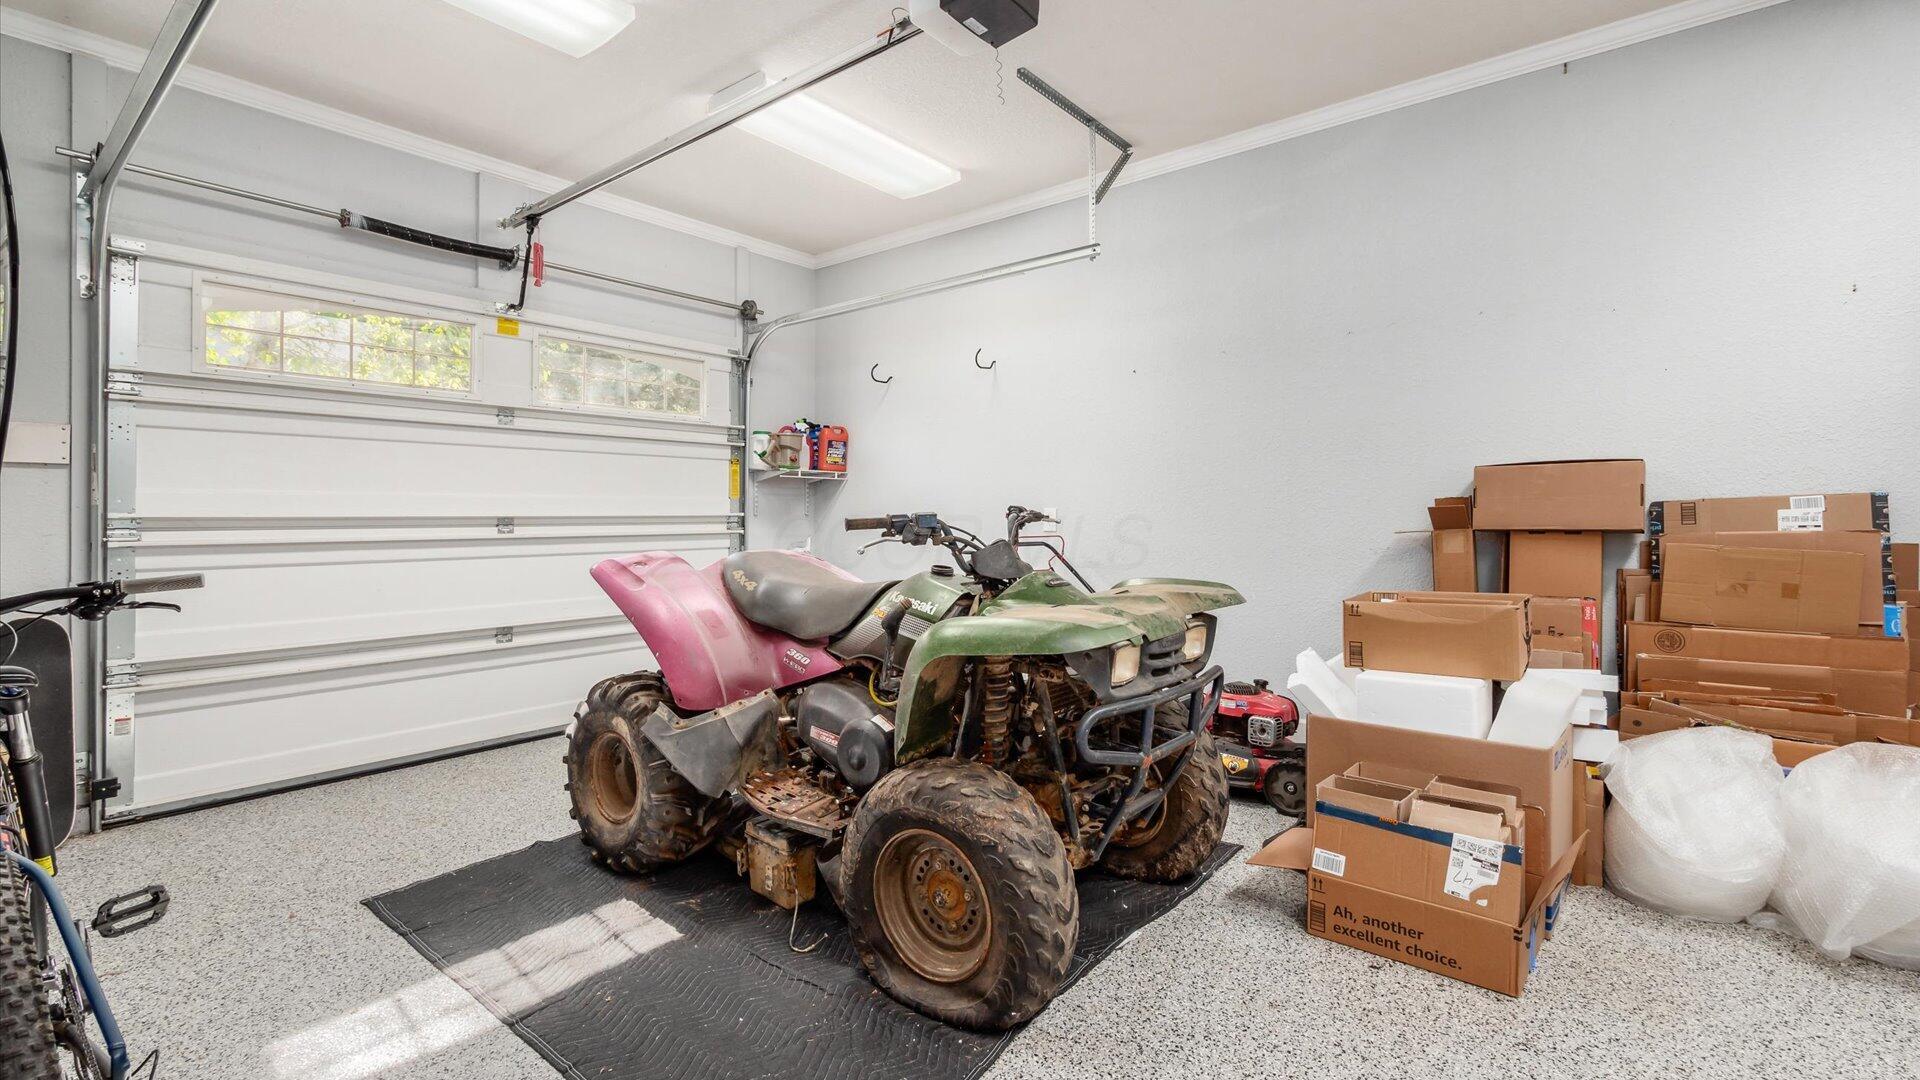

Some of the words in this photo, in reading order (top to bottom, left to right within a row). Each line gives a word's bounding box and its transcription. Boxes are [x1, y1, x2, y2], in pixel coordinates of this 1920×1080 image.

[732, 570, 758, 592] 4x4
[890, 591, 939, 615] Kasaki
[786, 648, 811, 665] 360
[1333, 905, 1357, 923] Ah,
[1362, 914, 1424, 940] another
[1333, 923, 1401, 952] excellent
[1405, 944, 1462, 970] choice.
